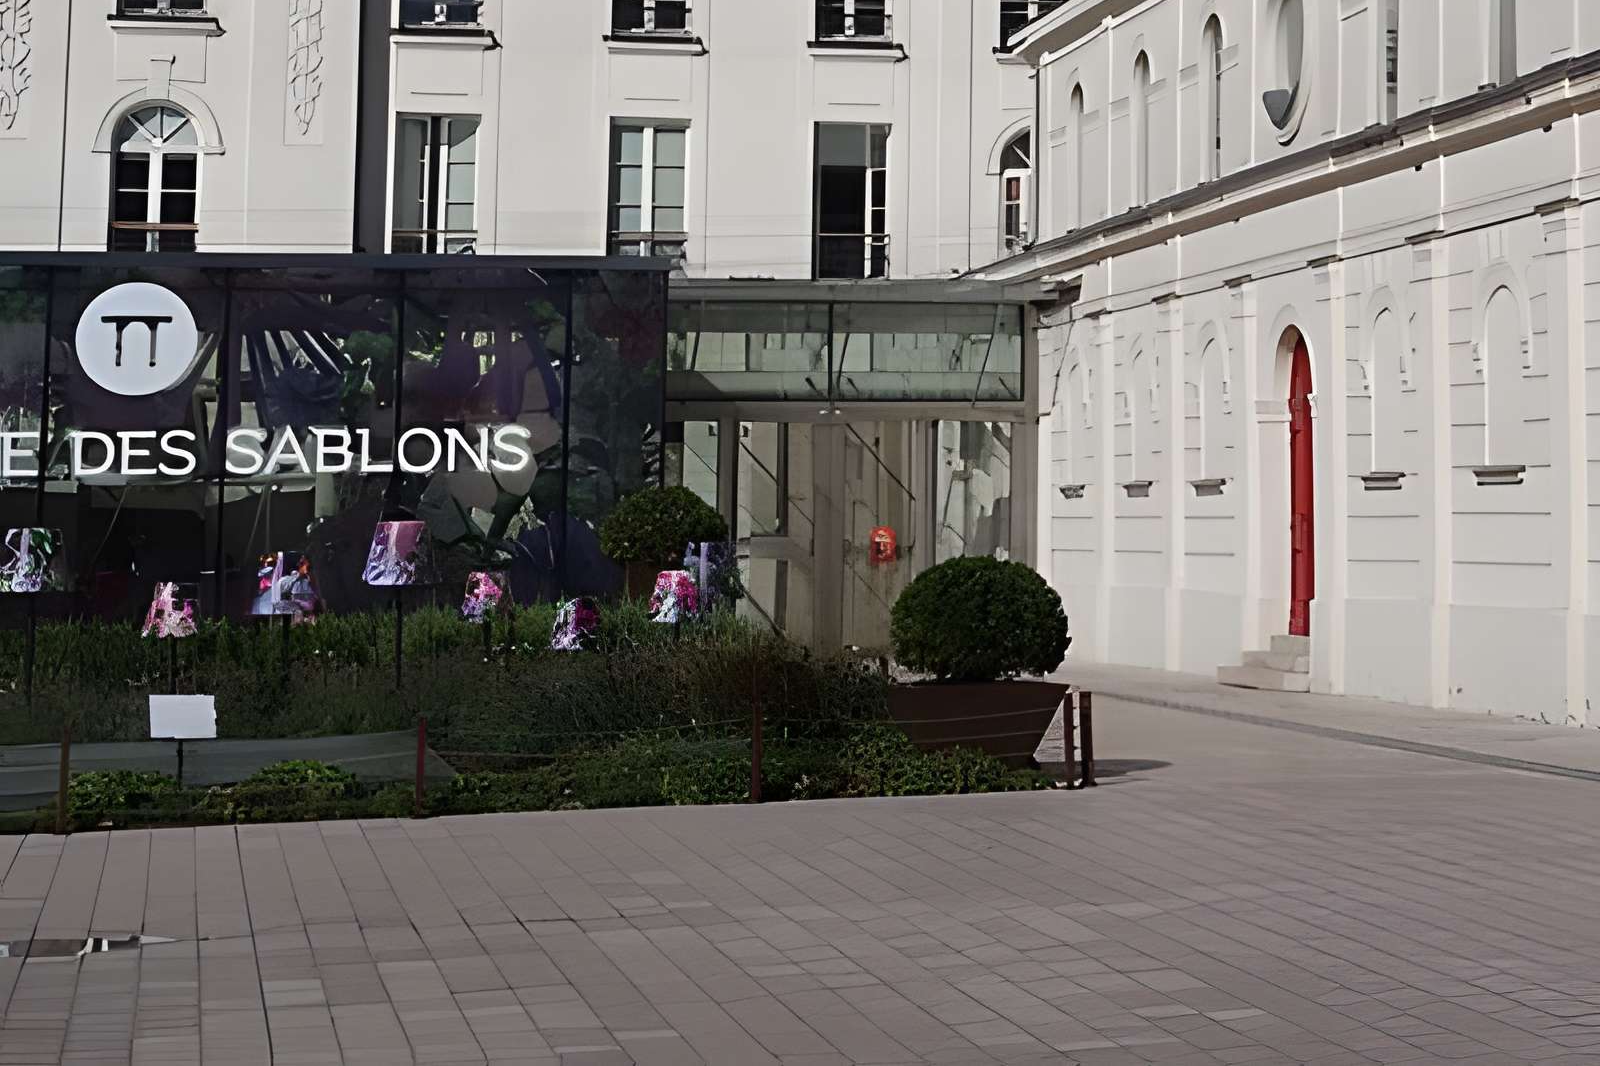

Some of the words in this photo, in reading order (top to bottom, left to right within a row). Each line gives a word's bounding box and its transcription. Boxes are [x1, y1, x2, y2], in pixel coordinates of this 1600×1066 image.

[1, 431, 40, 477] E
[70, 429, 196, 476] DES
[225, 424, 531, 475] SABLONS
